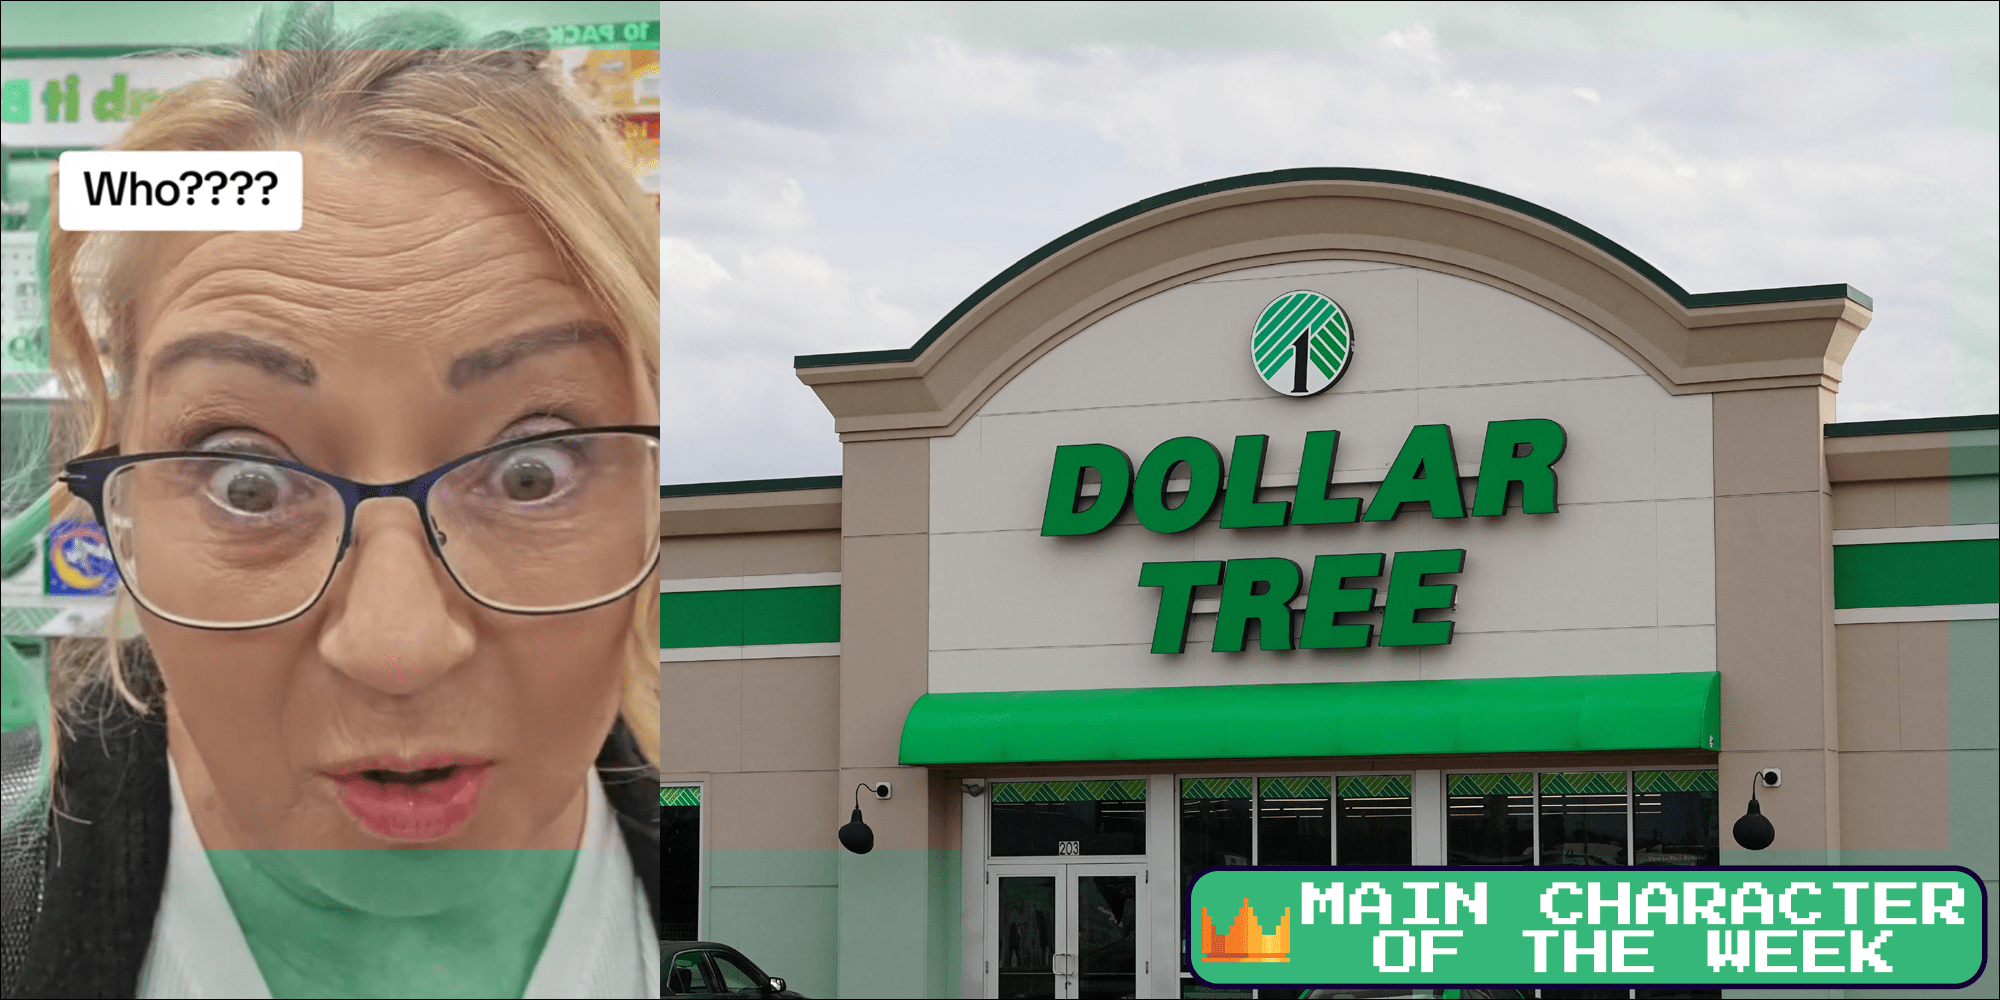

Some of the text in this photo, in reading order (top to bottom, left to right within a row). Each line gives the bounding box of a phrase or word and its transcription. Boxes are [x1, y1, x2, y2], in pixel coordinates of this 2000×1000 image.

[1040, 418, 1568, 537] DOLLAR
[1138, 548, 1468, 655] TREE
[1059, 841, 1079, 855] 203
